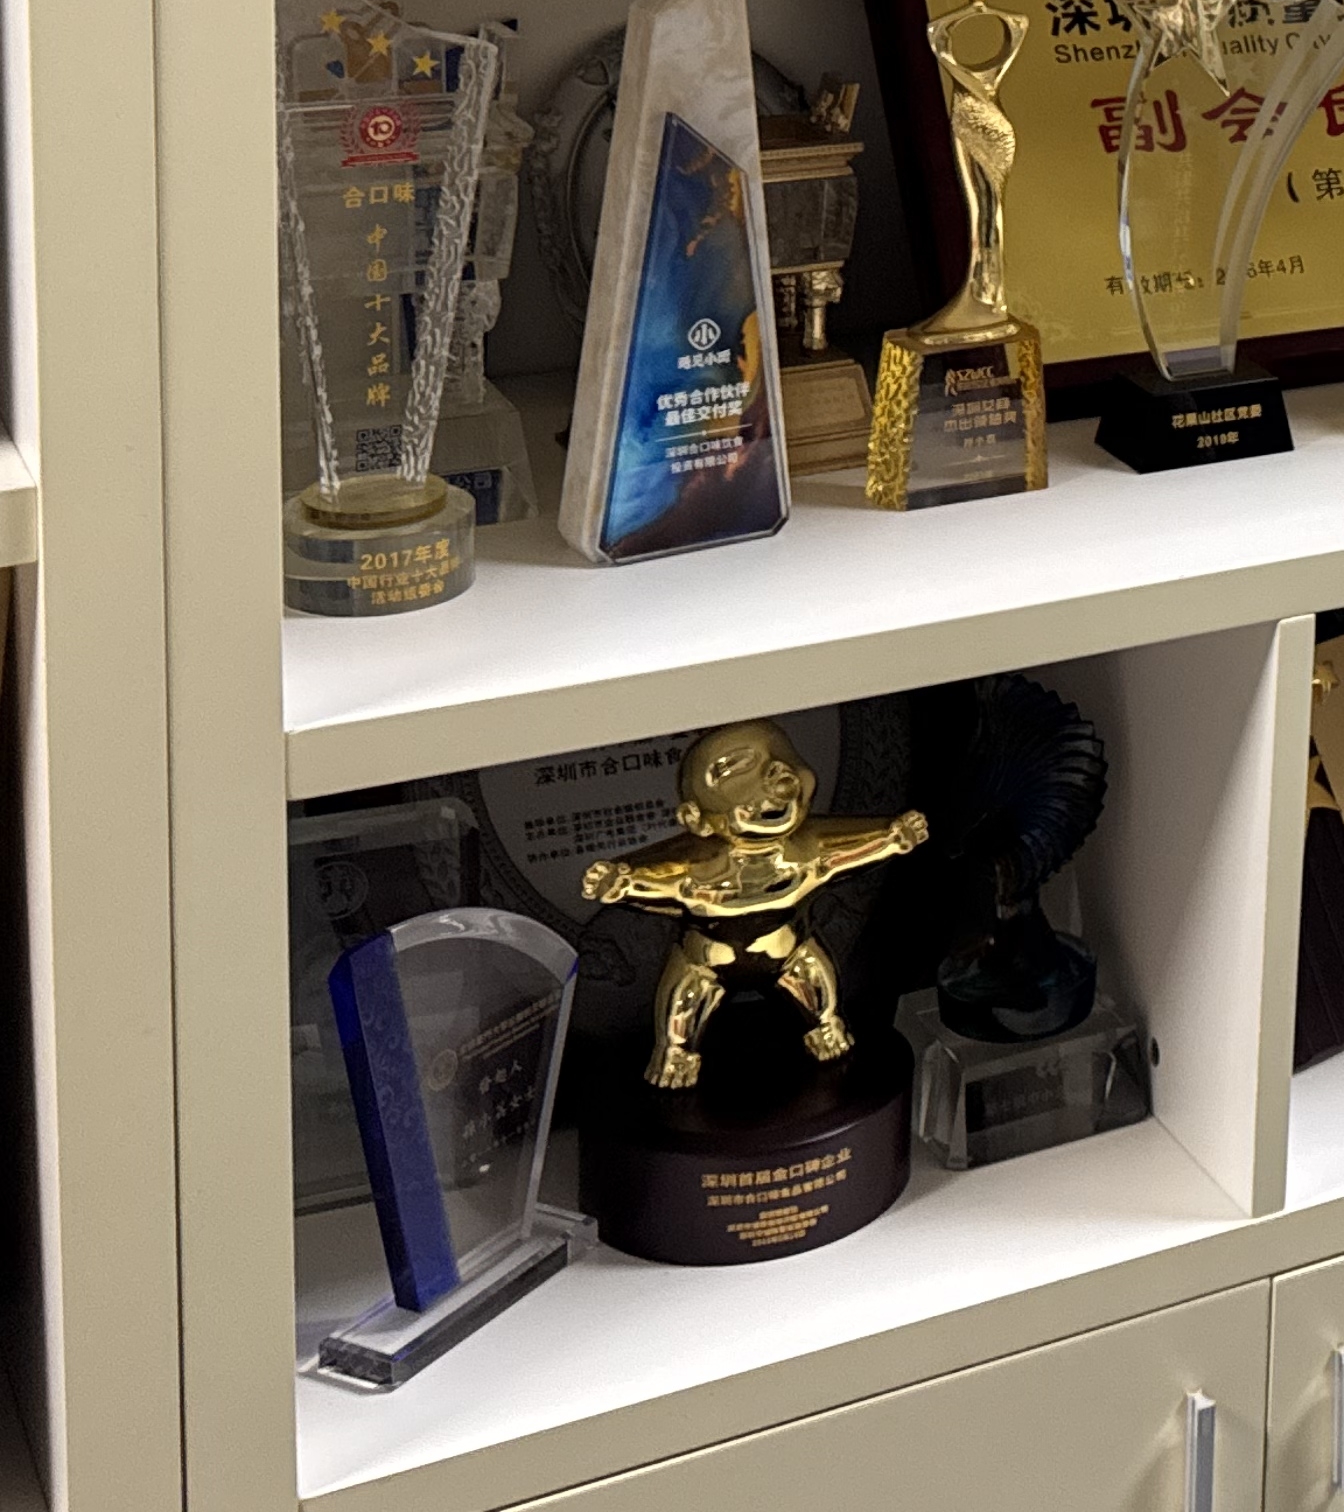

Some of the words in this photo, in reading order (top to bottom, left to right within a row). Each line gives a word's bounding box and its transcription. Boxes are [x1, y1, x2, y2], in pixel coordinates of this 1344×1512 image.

[343, 183, 415, 209] 合口味
[364, 224, 391, 407] 中国十大品牌
[656, 381, 750, 411] 优秀合作伙伴
[664, 400, 743, 427] 最佳交付奖
[360, 538, 450, 571] 2017年度
